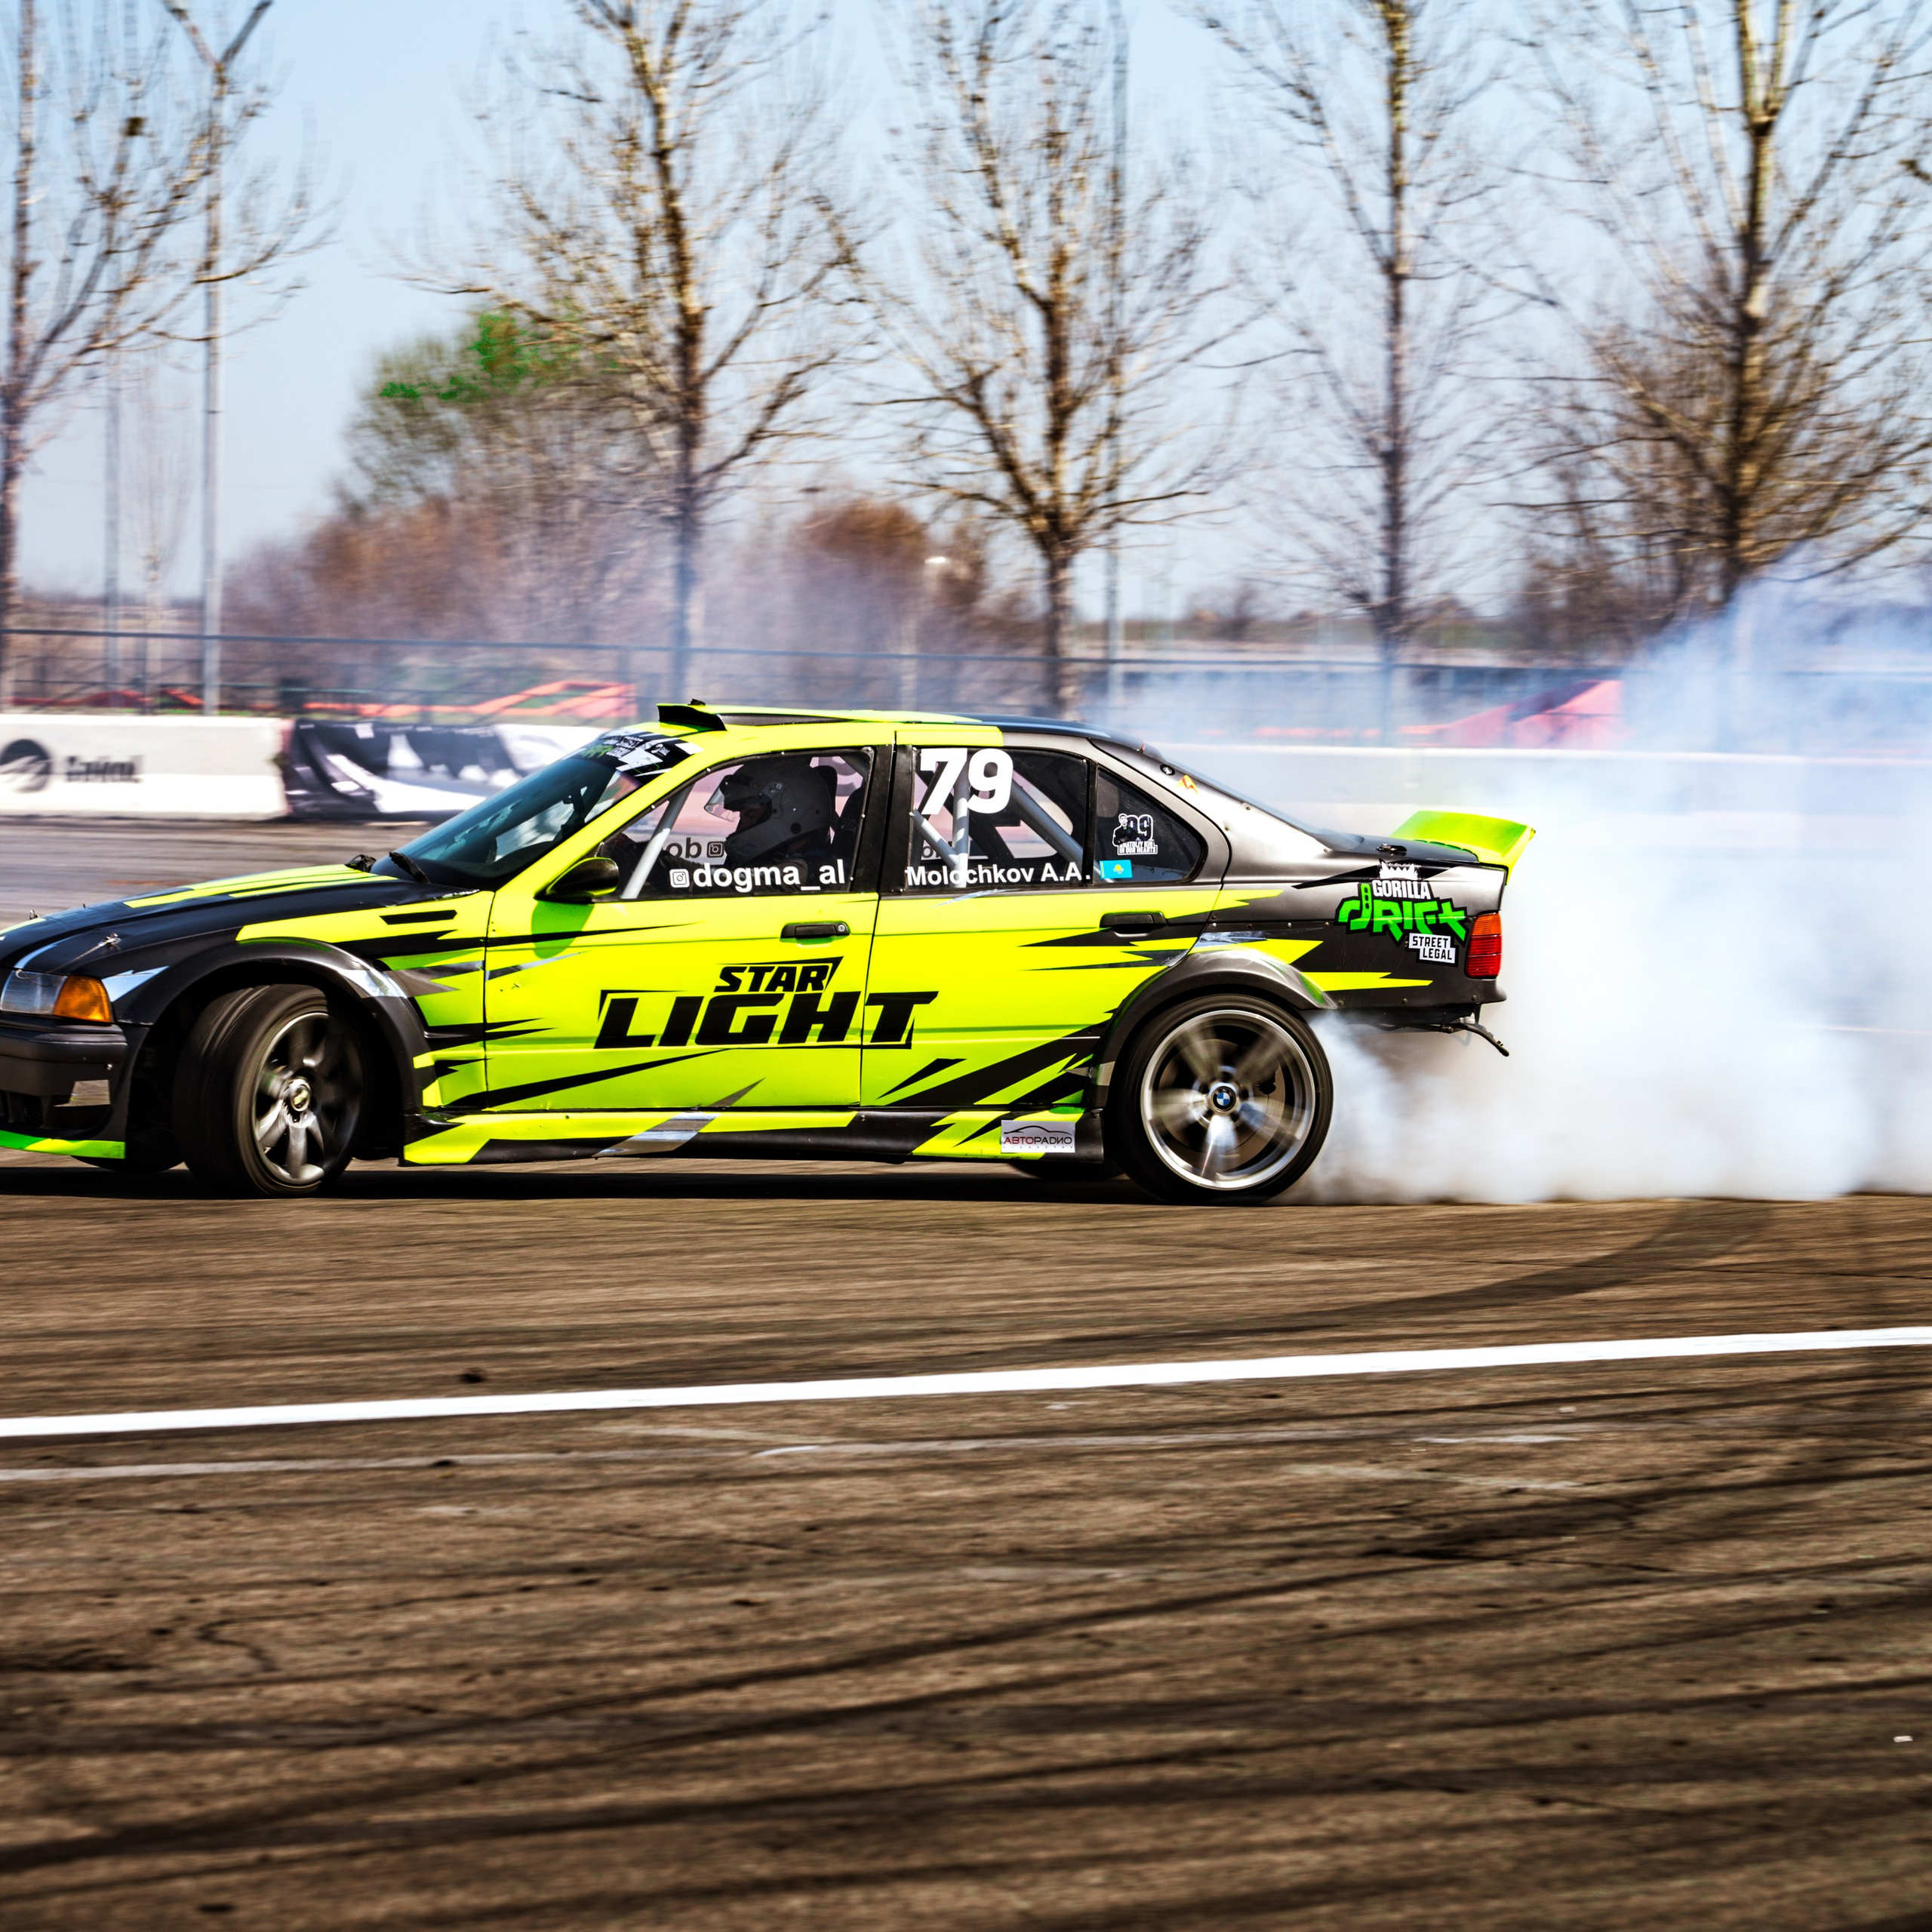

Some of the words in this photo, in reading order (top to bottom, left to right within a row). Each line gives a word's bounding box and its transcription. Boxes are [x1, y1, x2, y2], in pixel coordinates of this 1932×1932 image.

[920, 747, 1014, 815] 79
[693, 859, 845, 893] dogma_al
[906, 863, 1035, 886] Molochkov
[1041, 861, 1091, 882] A.A.
[1372, 879, 1432, 900] GORILLA
[1412, 935, 1449, 949] STREET
[1423, 948, 1453, 960] LEGAL
[713, 965, 829, 992] STAR
[593, 991, 939, 1049] LIGHT
